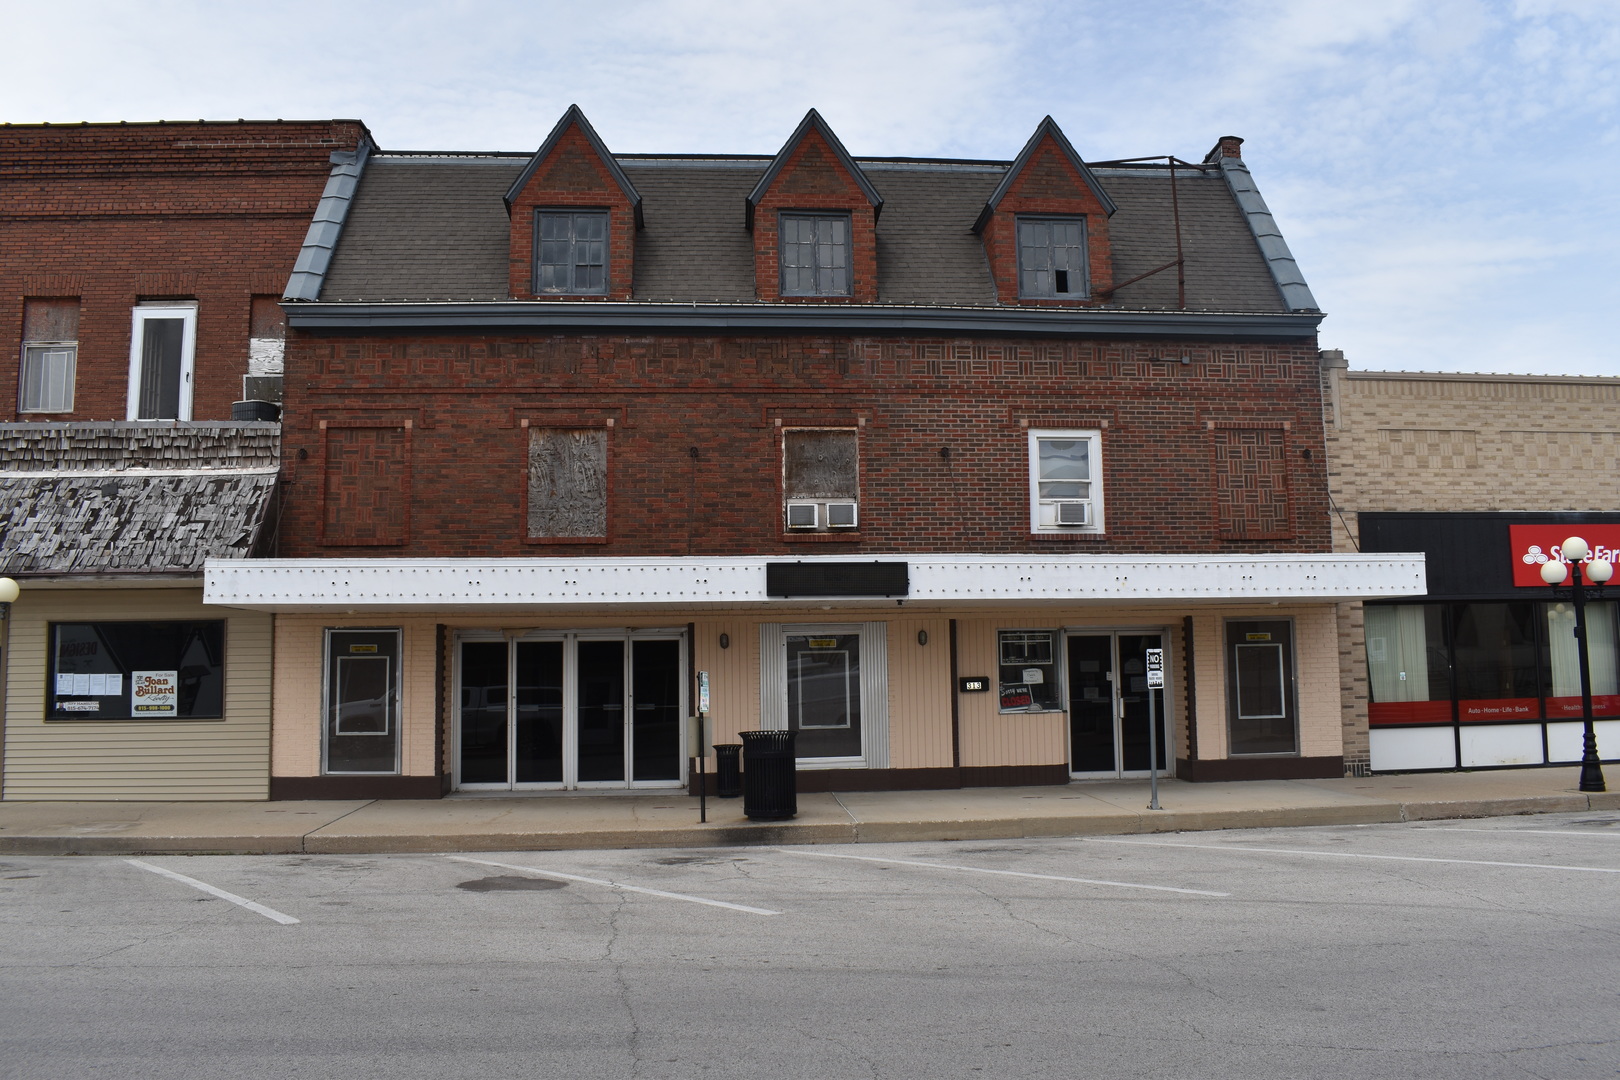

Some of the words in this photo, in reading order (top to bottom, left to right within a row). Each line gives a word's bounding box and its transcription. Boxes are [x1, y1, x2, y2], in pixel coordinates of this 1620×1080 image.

[1550, 545, 1594, 564] Ste
[1594, 545, 1620, 563] Far
[1150, 654, 1160, 663] NO
[144, 676, 168, 688] Joan
[135, 685, 174, 697] Bullard
[1001, 695, 1030, 707] CLOSED
